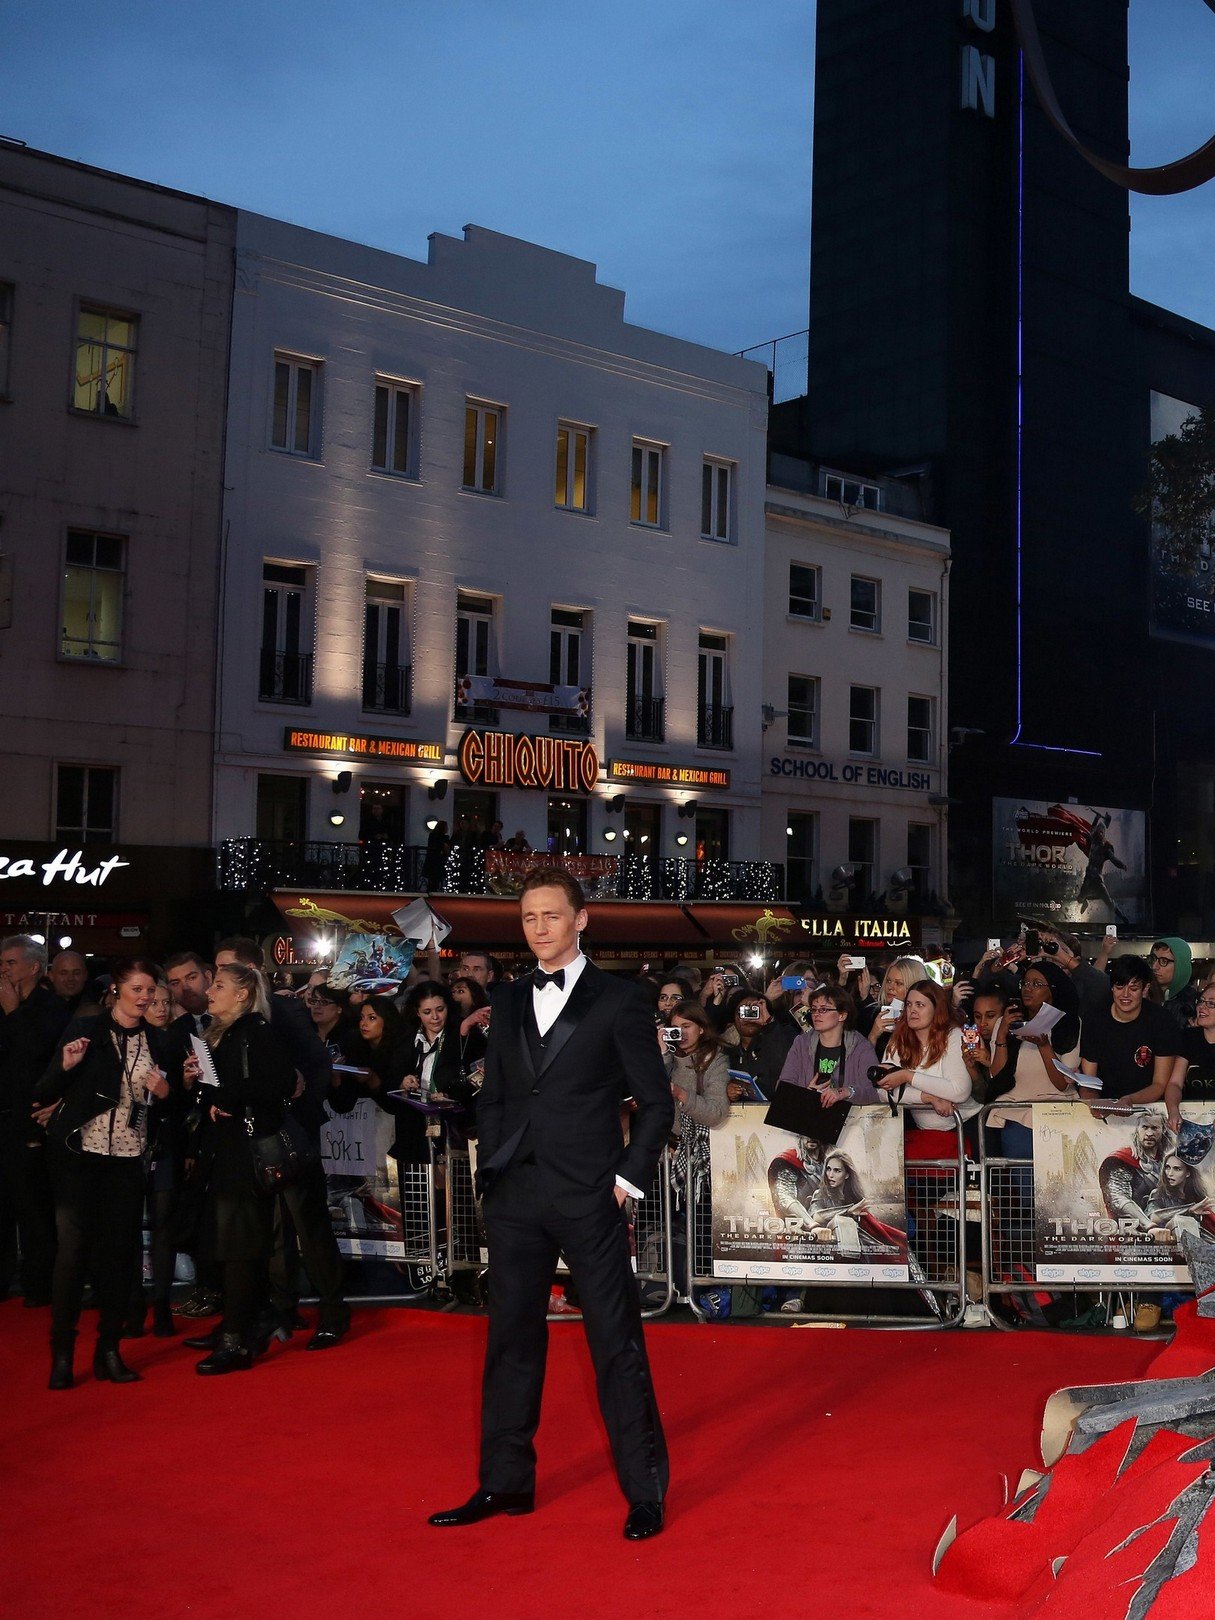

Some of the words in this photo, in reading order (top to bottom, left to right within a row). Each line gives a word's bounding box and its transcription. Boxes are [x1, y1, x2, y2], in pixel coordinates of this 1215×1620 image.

[1187, 597, 1210, 612] SEE
[291, 732, 348, 752] RESTAURANT
[349, 738, 367, 753] BAR
[370, 741, 376, 753] &
[379, 741, 416, 757] MEXICAN
[418, 745, 441, 760] GRILL
[461, 729, 599, 793] CHIQUITO
[613, 763, 656, 778] RESTAURANT
[657, 767, 671, 780] BAR
[672, 769, 678, 781] &
[679, 769, 708, 783] MEXICAN
[709, 772, 727, 785] GRILL
[771, 757, 838, 780] SCHOOL
[842, 765, 864, 782] OF
[867, 767, 931, 790] ENGLISH
[1005, 842, 1066, 864] THOR
[42, 848, 131, 886] Hut
[854, 919, 911, 939] ITALIA
[724, 1215, 805, 1235] THOR
[1048, 1217, 1140, 1236] THOR
